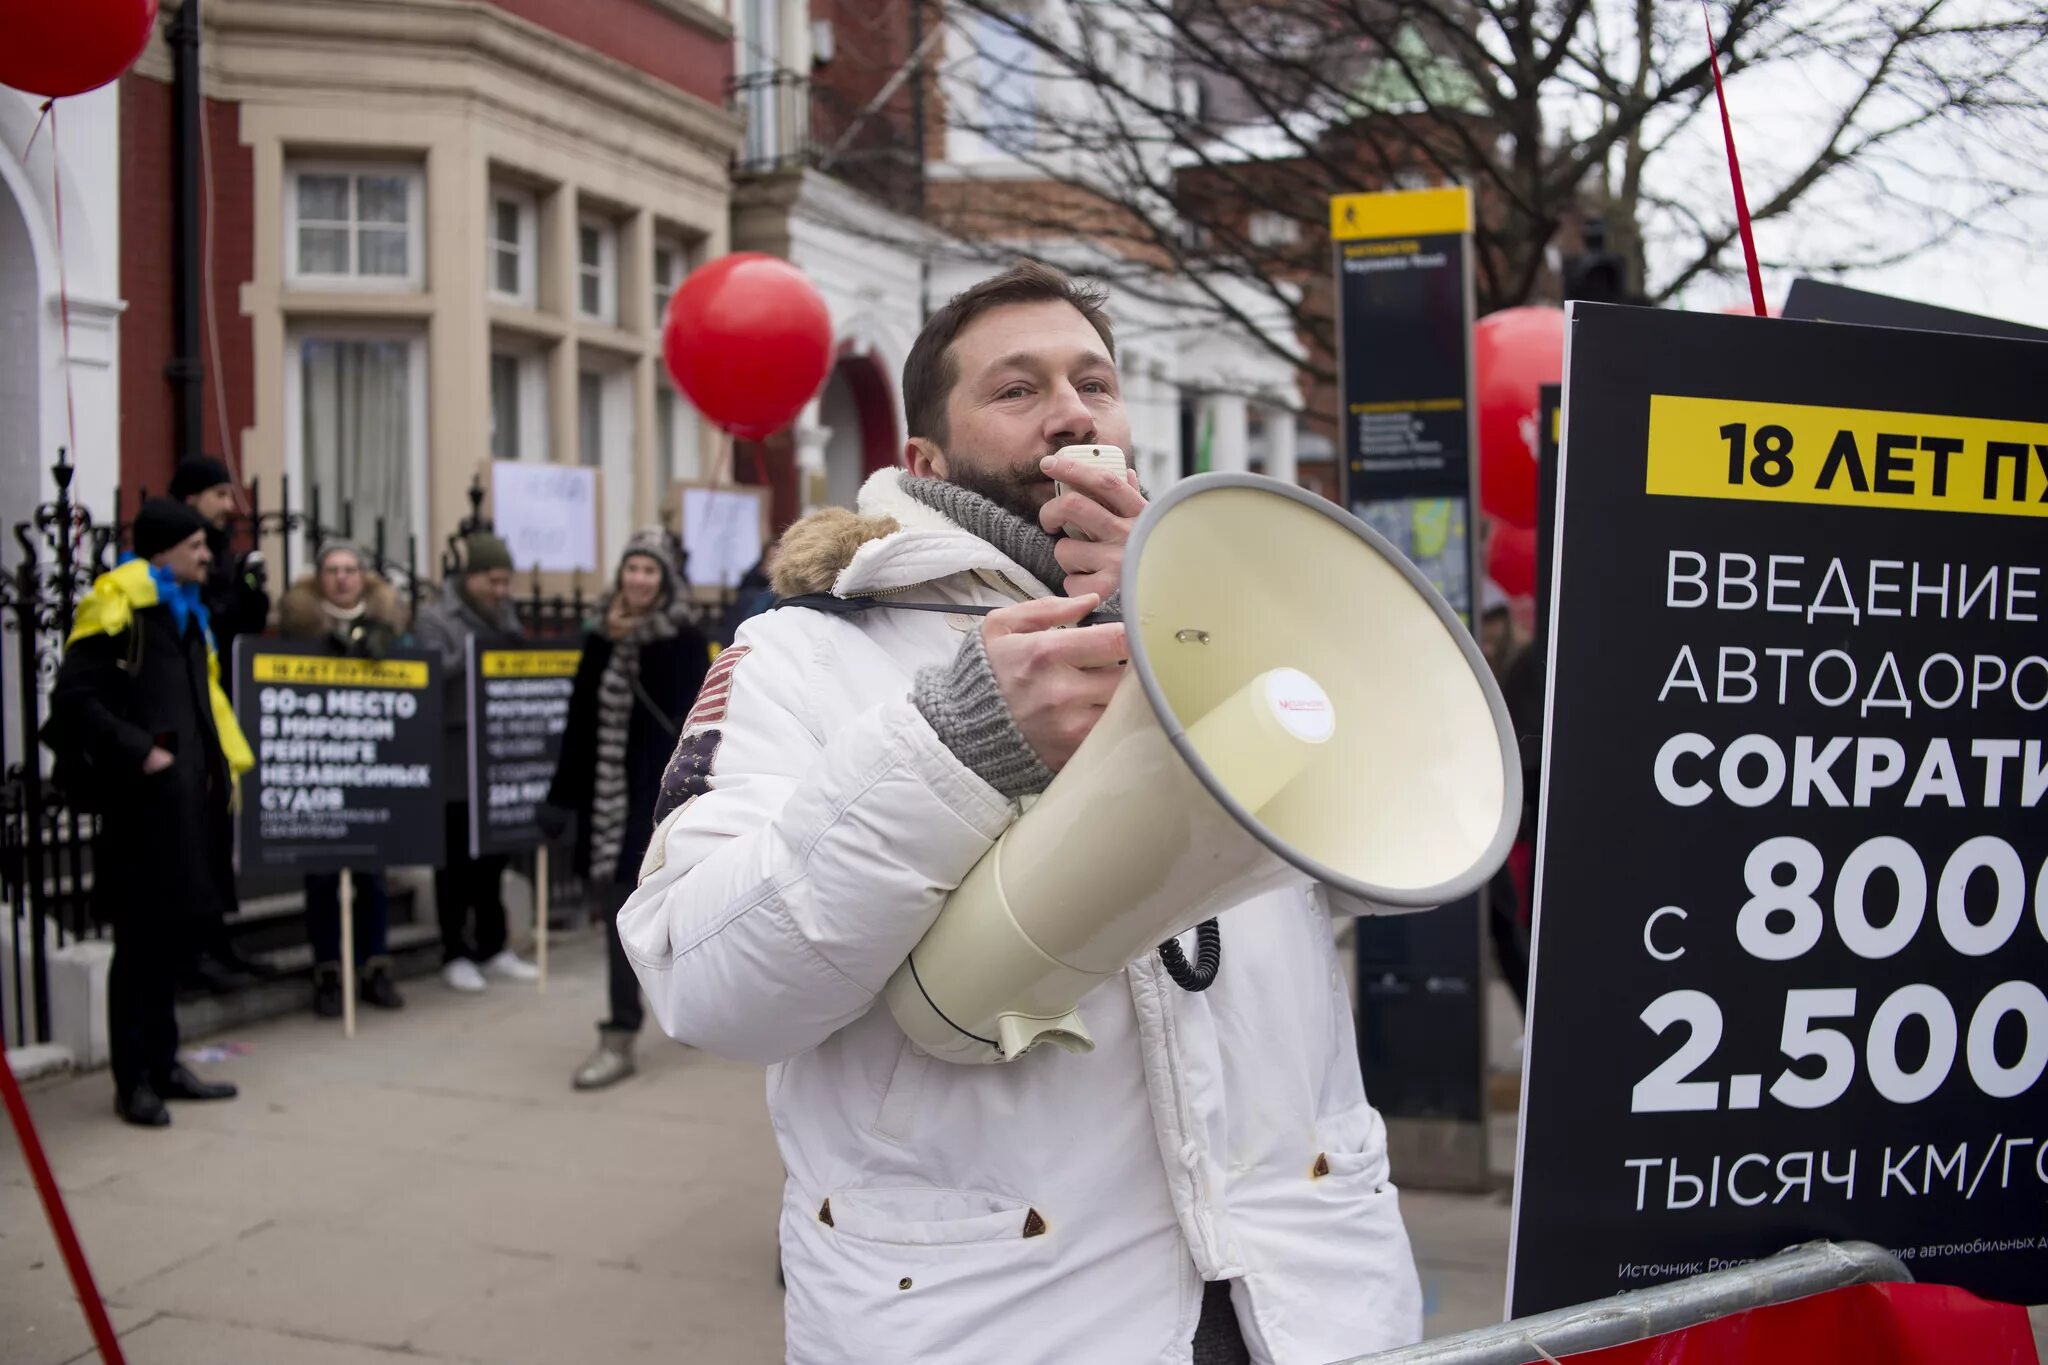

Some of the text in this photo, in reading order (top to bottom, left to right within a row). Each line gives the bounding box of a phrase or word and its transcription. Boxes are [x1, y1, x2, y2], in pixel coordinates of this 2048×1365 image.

[1719, 422, 1794, 488] 18
[1814, 429, 1965, 497] ЛЕТ
[1666, 549, 2041, 626] ВВЕДЕНИЕ
[326, 690, 417, 718] МЕСТО
[260, 715, 394, 741] В МИРОВОМ
[260, 738, 376, 763] РЕЙТИНГЕ
[260, 764, 430, 787] НЕЗАВИСИМЫХ
[261, 786, 344, 812] СУДОВ
[1735, 835, 2048, 961] 800
[1631, 980, 2048, 1113] 2.500
[1624, 1133, 2048, 1211] ТЫСЯЧ КМ/Г
[1618, 1262, 1704, 1278] Источник:
[1919, 1238, 2035, 1258] автомобильных
